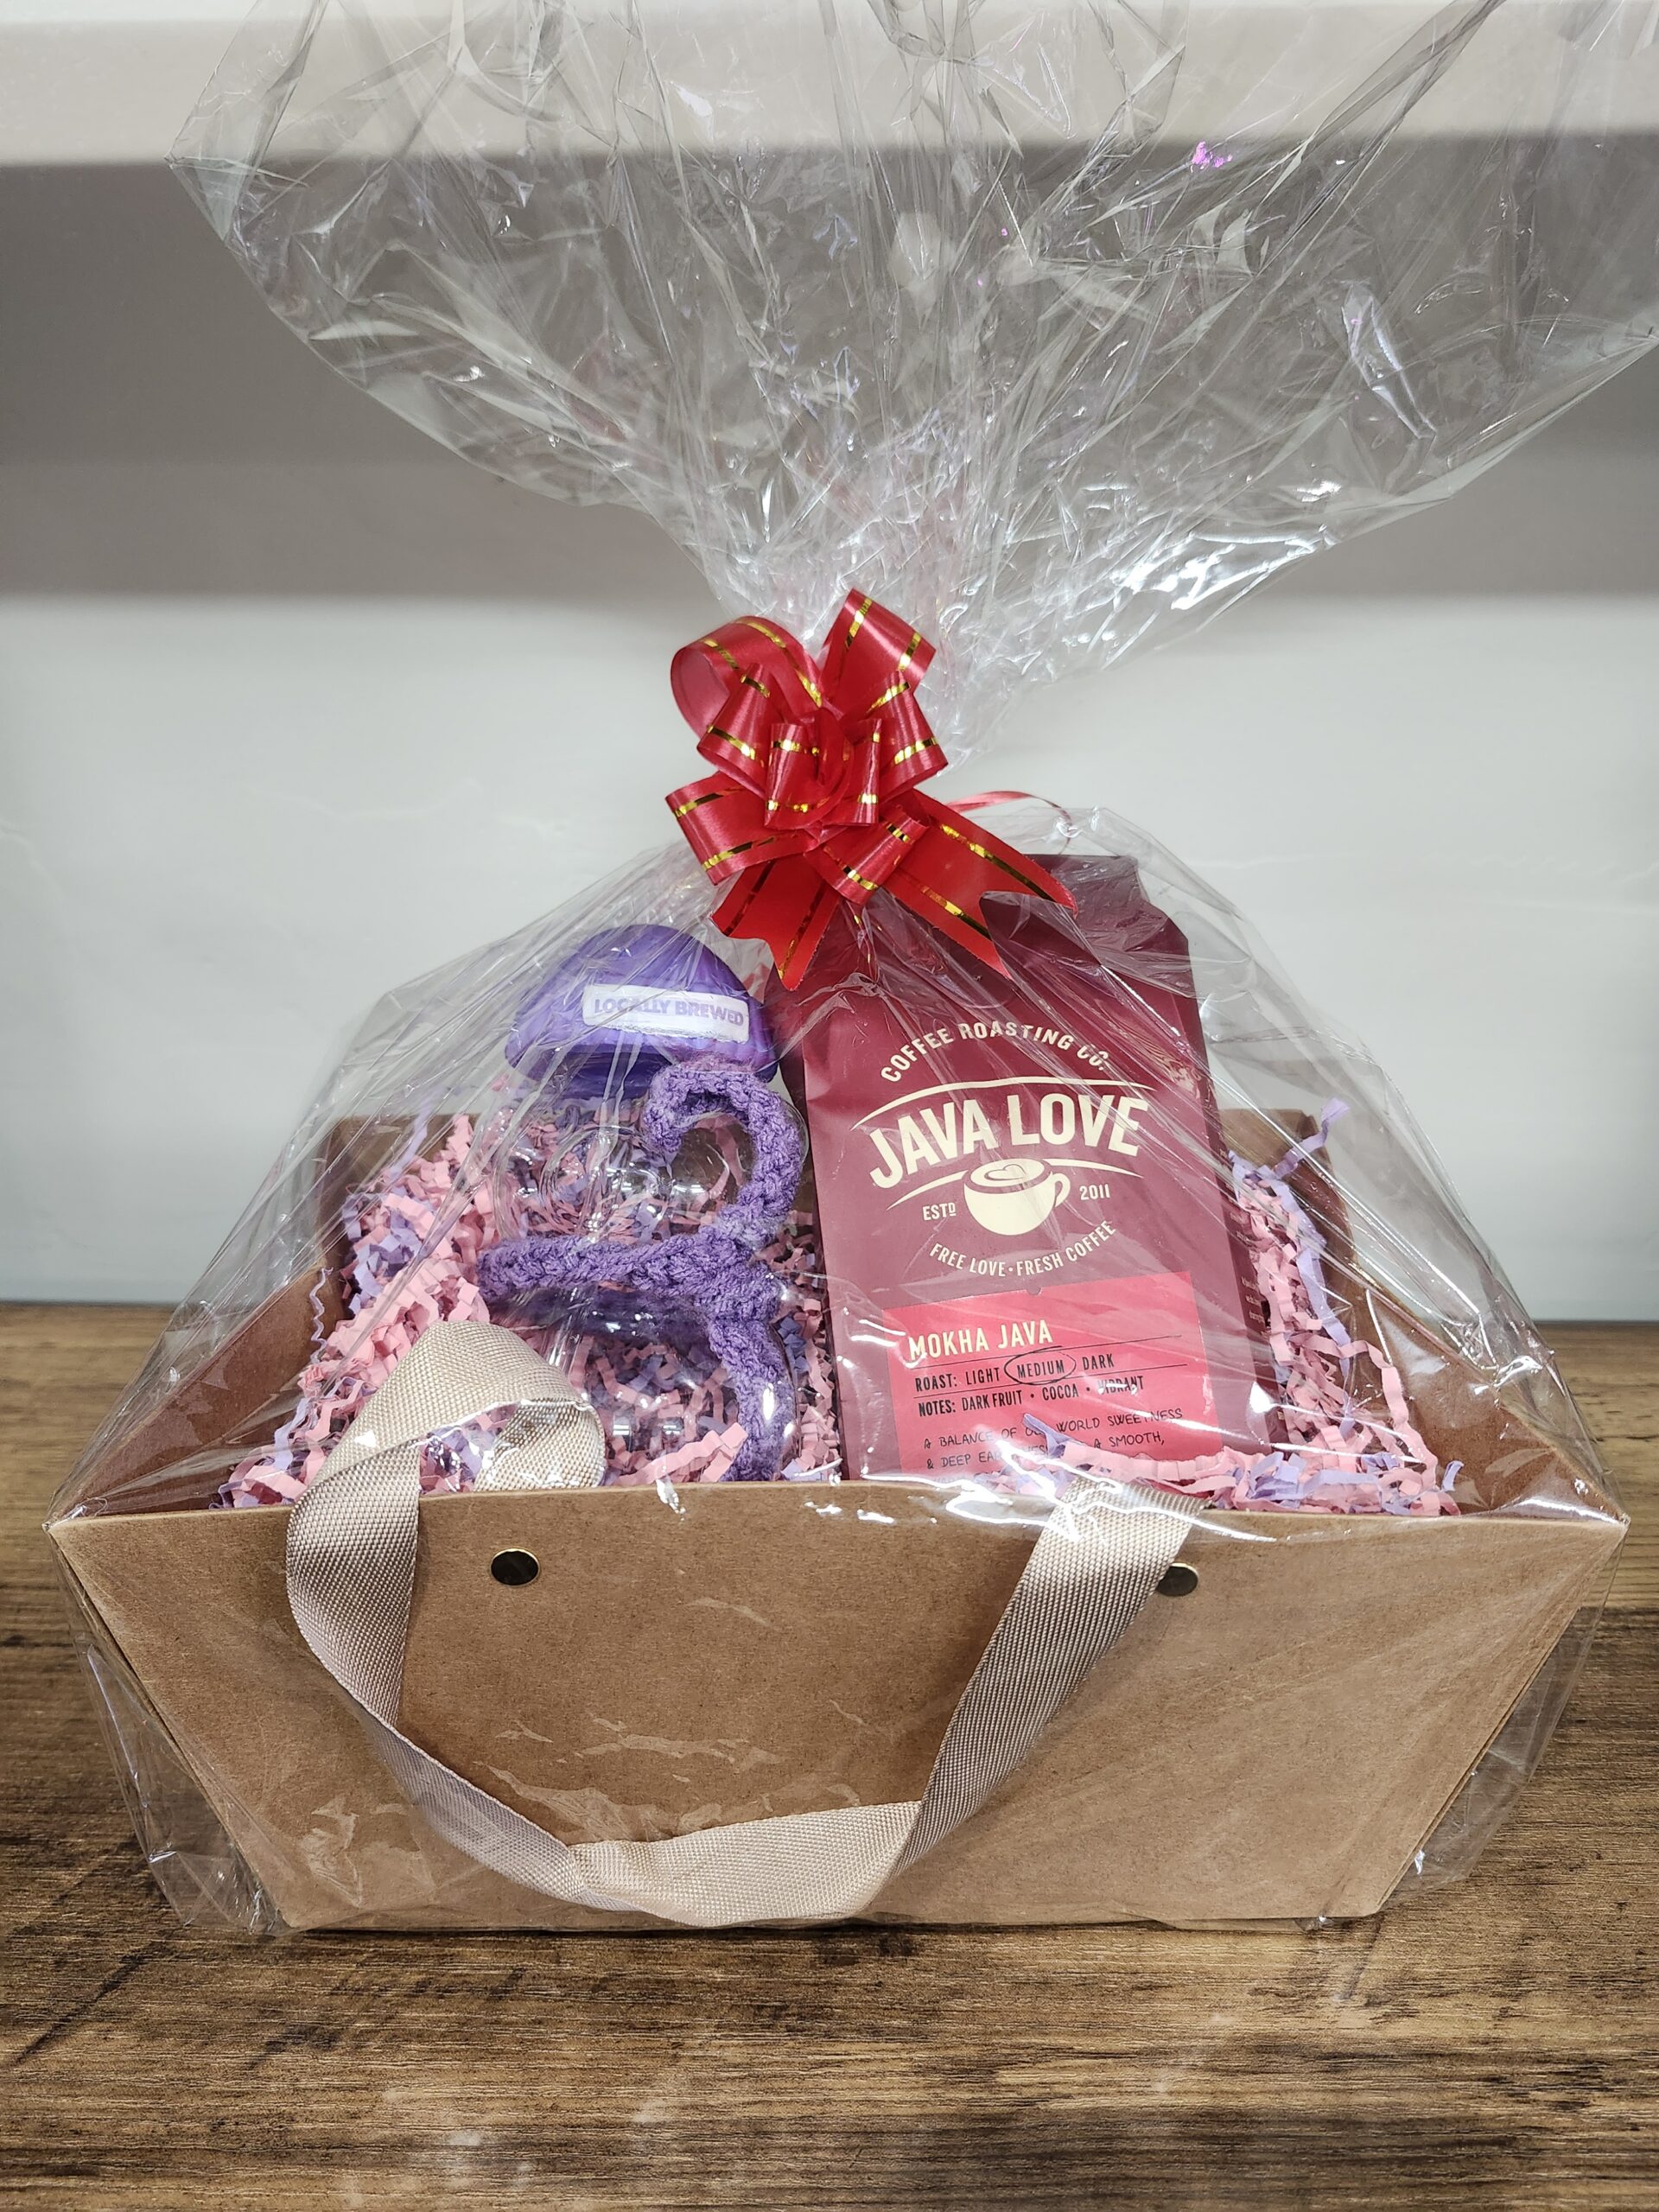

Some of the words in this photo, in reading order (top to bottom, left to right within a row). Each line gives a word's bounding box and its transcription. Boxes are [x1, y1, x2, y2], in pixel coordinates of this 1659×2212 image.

[675, 1001, 744, 1026] BREWED
[880, 1027, 954, 1082] COFFEE
[958, 1021, 1074, 1050] ROASTING
[869, 1099, 999, 1189] JAVA
[1007, 1093, 1148, 1157] LOVE
[1080, 1184, 1110, 1200] 2011
[929, 1243, 966, 1269] FREE
[969, 1257, 1006, 1277] LOVE
[1016, 1252, 1064, 1276] FRESH
[1065, 1220, 1116, 1262] COFFEE
[908, 1327, 989, 1360] MOKHA
[998, 1319, 1052, 1349] JAVA
[915, 1376, 957, 1392] ROAST:
[965, 1367, 1001, 1385] LIGHT
[1016, 1359, 1065, 1379] MEDIUM
[1083, 1353, 1115, 1370] DARK
[918, 1402, 956, 1417] NOTES:
[962, 1393, 990, 1411] DARK
[993, 1390, 1022, 1408] FRUIT
[1042, 1383, 1079, 1401] COCOA
[924, 1438, 931, 1449] A
[938, 1431, 993, 1446] BALANCE
[1001, 1427, 1016, 1439] OF
[1056, 1418, 1100, 1432] WORLD
[927, 1459, 934, 1469] &
[941, 1453, 971, 1467] DEEP
[1109, 1431, 1164, 1447] SMOOTH,
